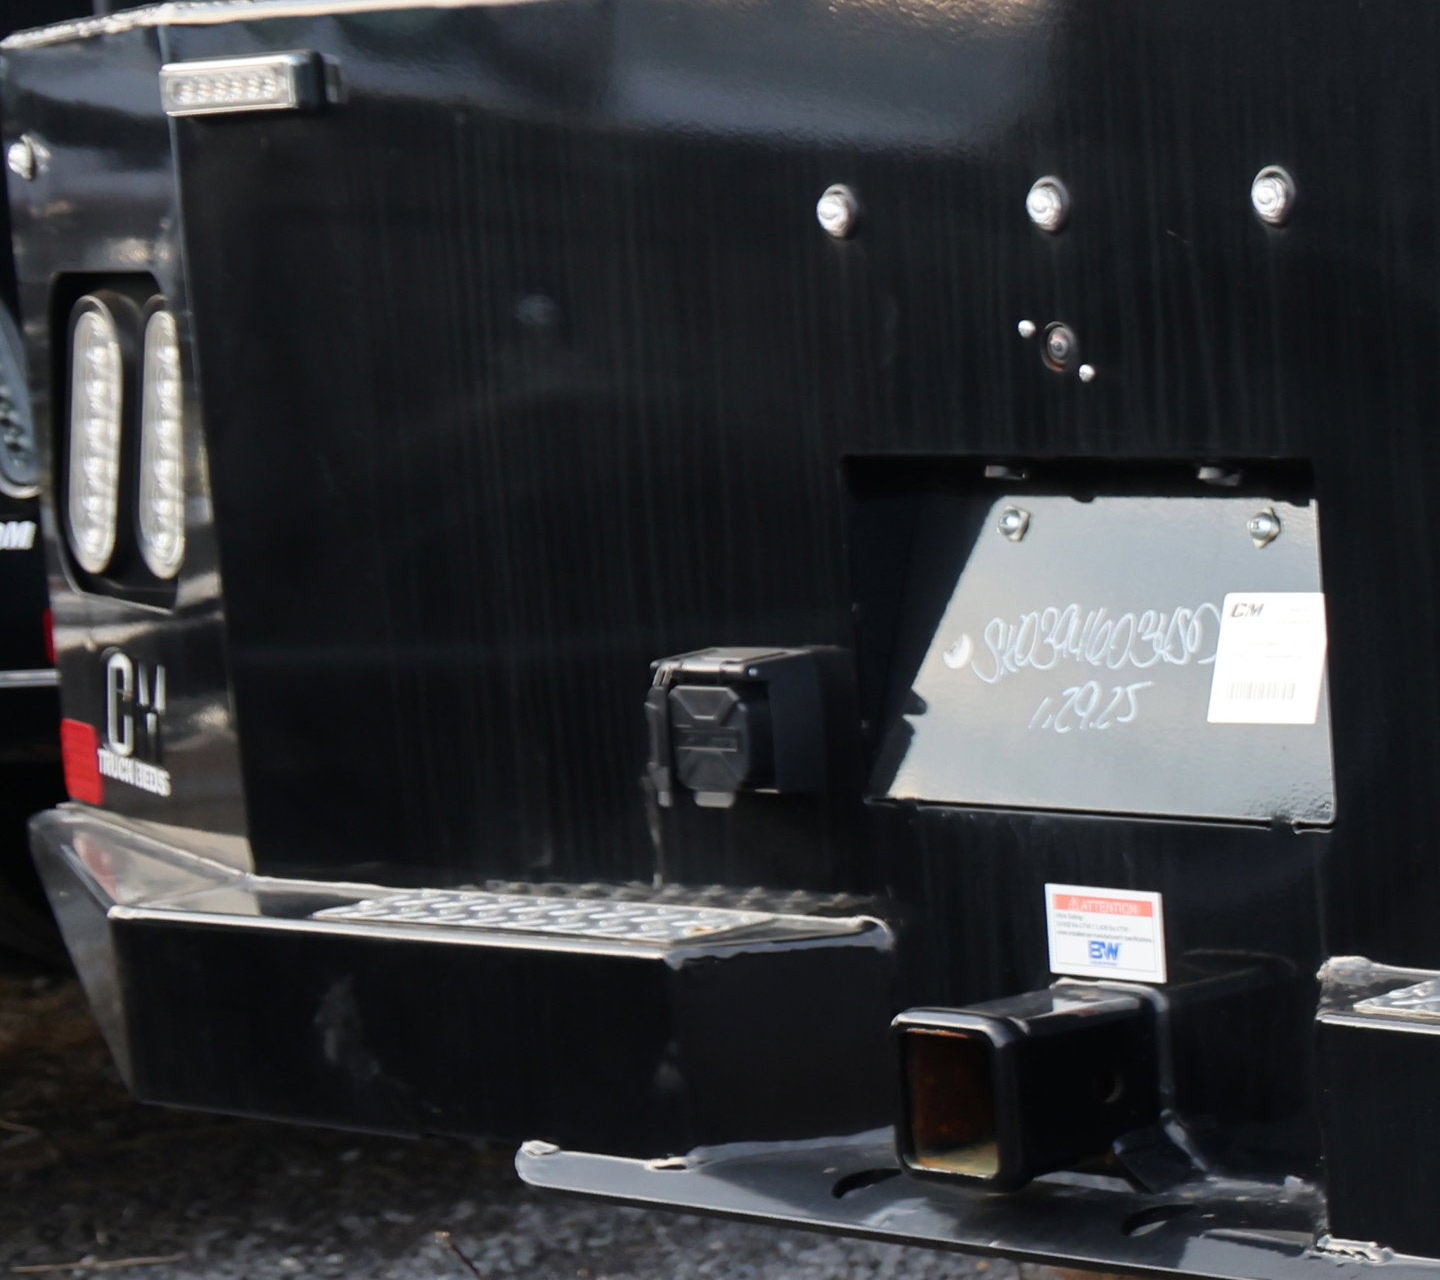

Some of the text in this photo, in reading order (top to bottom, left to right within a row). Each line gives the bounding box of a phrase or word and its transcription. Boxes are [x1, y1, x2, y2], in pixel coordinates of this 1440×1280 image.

[97, 748, 172, 797] TRUCK BEDS
[1081, 901, 1137, 916] ATTENTION
